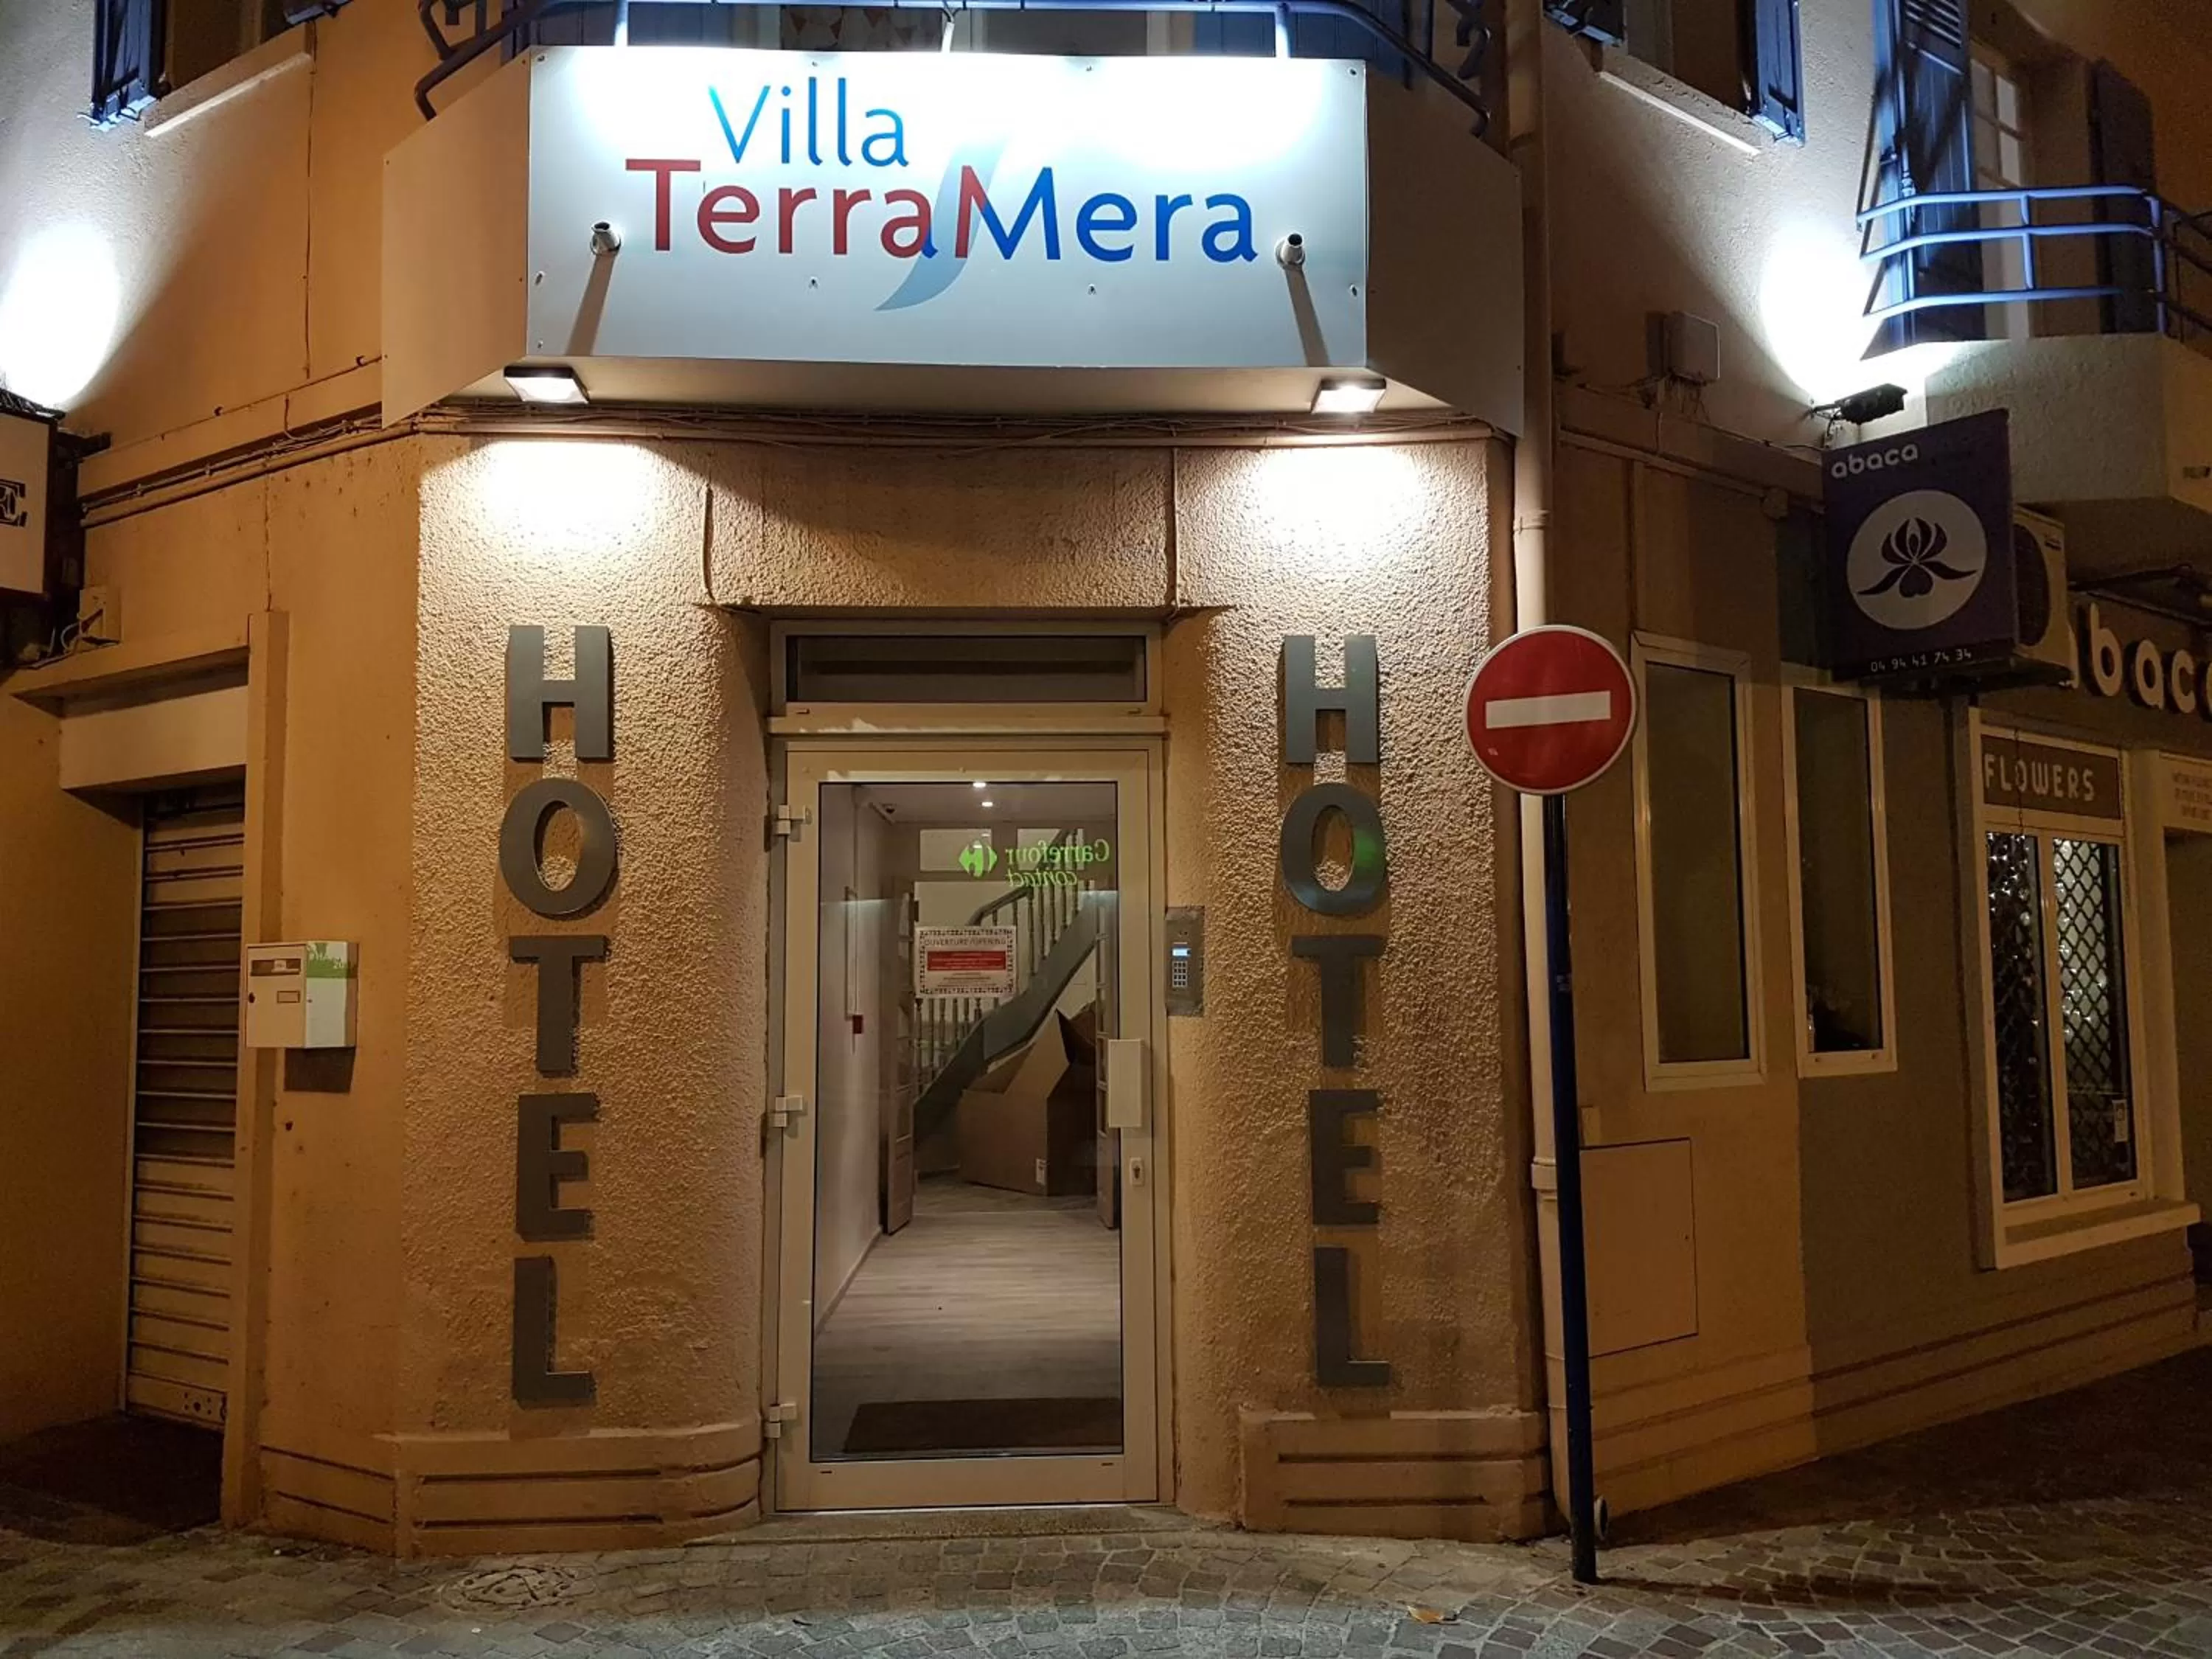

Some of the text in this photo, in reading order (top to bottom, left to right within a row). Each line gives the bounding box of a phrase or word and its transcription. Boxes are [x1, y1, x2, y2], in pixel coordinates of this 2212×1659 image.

[708, 76, 909, 169] Villa
[625, 158, 1258, 263] TerraMera
[1831, 443, 1919, 479] abaca
[1871, 661, 1886, 672] 04
[1891, 658, 1907, 670] 94
[1955, 648, 1972, 661] 34
[2067, 602, 2212, 717] bac
[1983, 754, 2096, 801] FLOWERS
[498, 625, 616, 1409] HOTEL
[1280, 634, 1391, 1389] HOTEL
